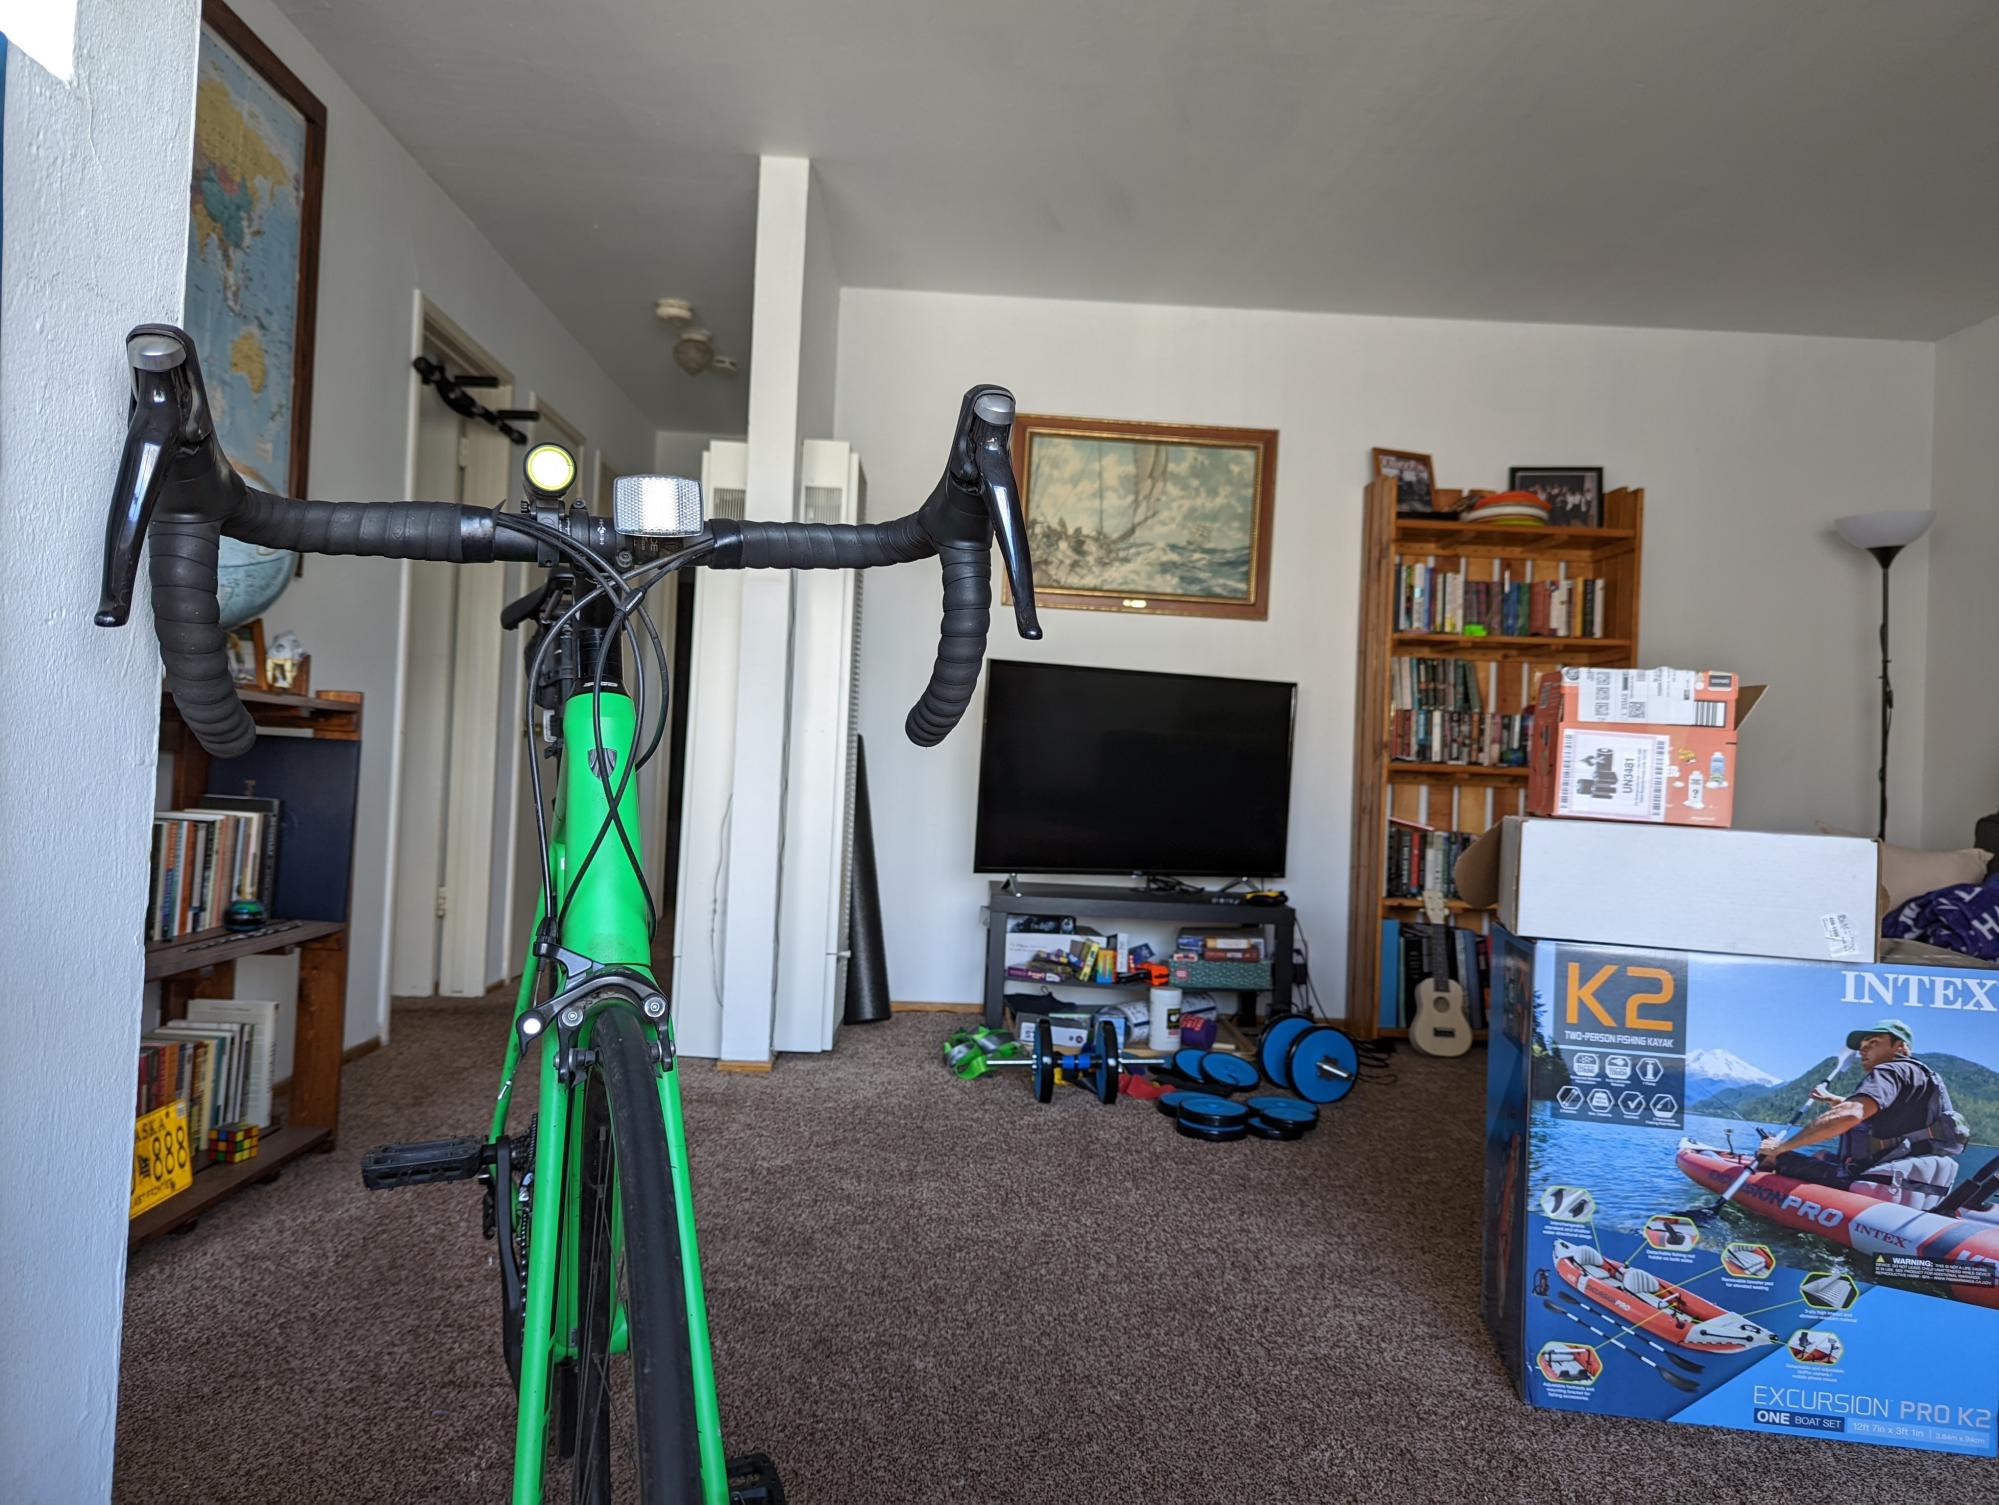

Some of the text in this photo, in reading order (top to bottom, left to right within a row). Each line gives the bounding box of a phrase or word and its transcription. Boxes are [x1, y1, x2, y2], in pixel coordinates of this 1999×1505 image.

[1622, 757, 1635, 795] UN3481
[1566, 962, 1675, 1031] K2
[1840, 970, 1998, 1012] INTEX
[1564, 1030, 1674, 1048] TWO-PERSON FISHING KAYAK
[1781, 1195, 1845, 1228] PRO
[1855, 1223, 1908, 1249] INTEX
[1753, 1385, 1992, 1429] EXCURSION PRO K2
[1756, 1410, 1842, 1430] ONE BOAT SET
[1852, 1421, 1870, 1433] 12ft
[1872, 1422, 1886, 1434] 7in
[1895, 1425, 1910, 1436] 3ft
